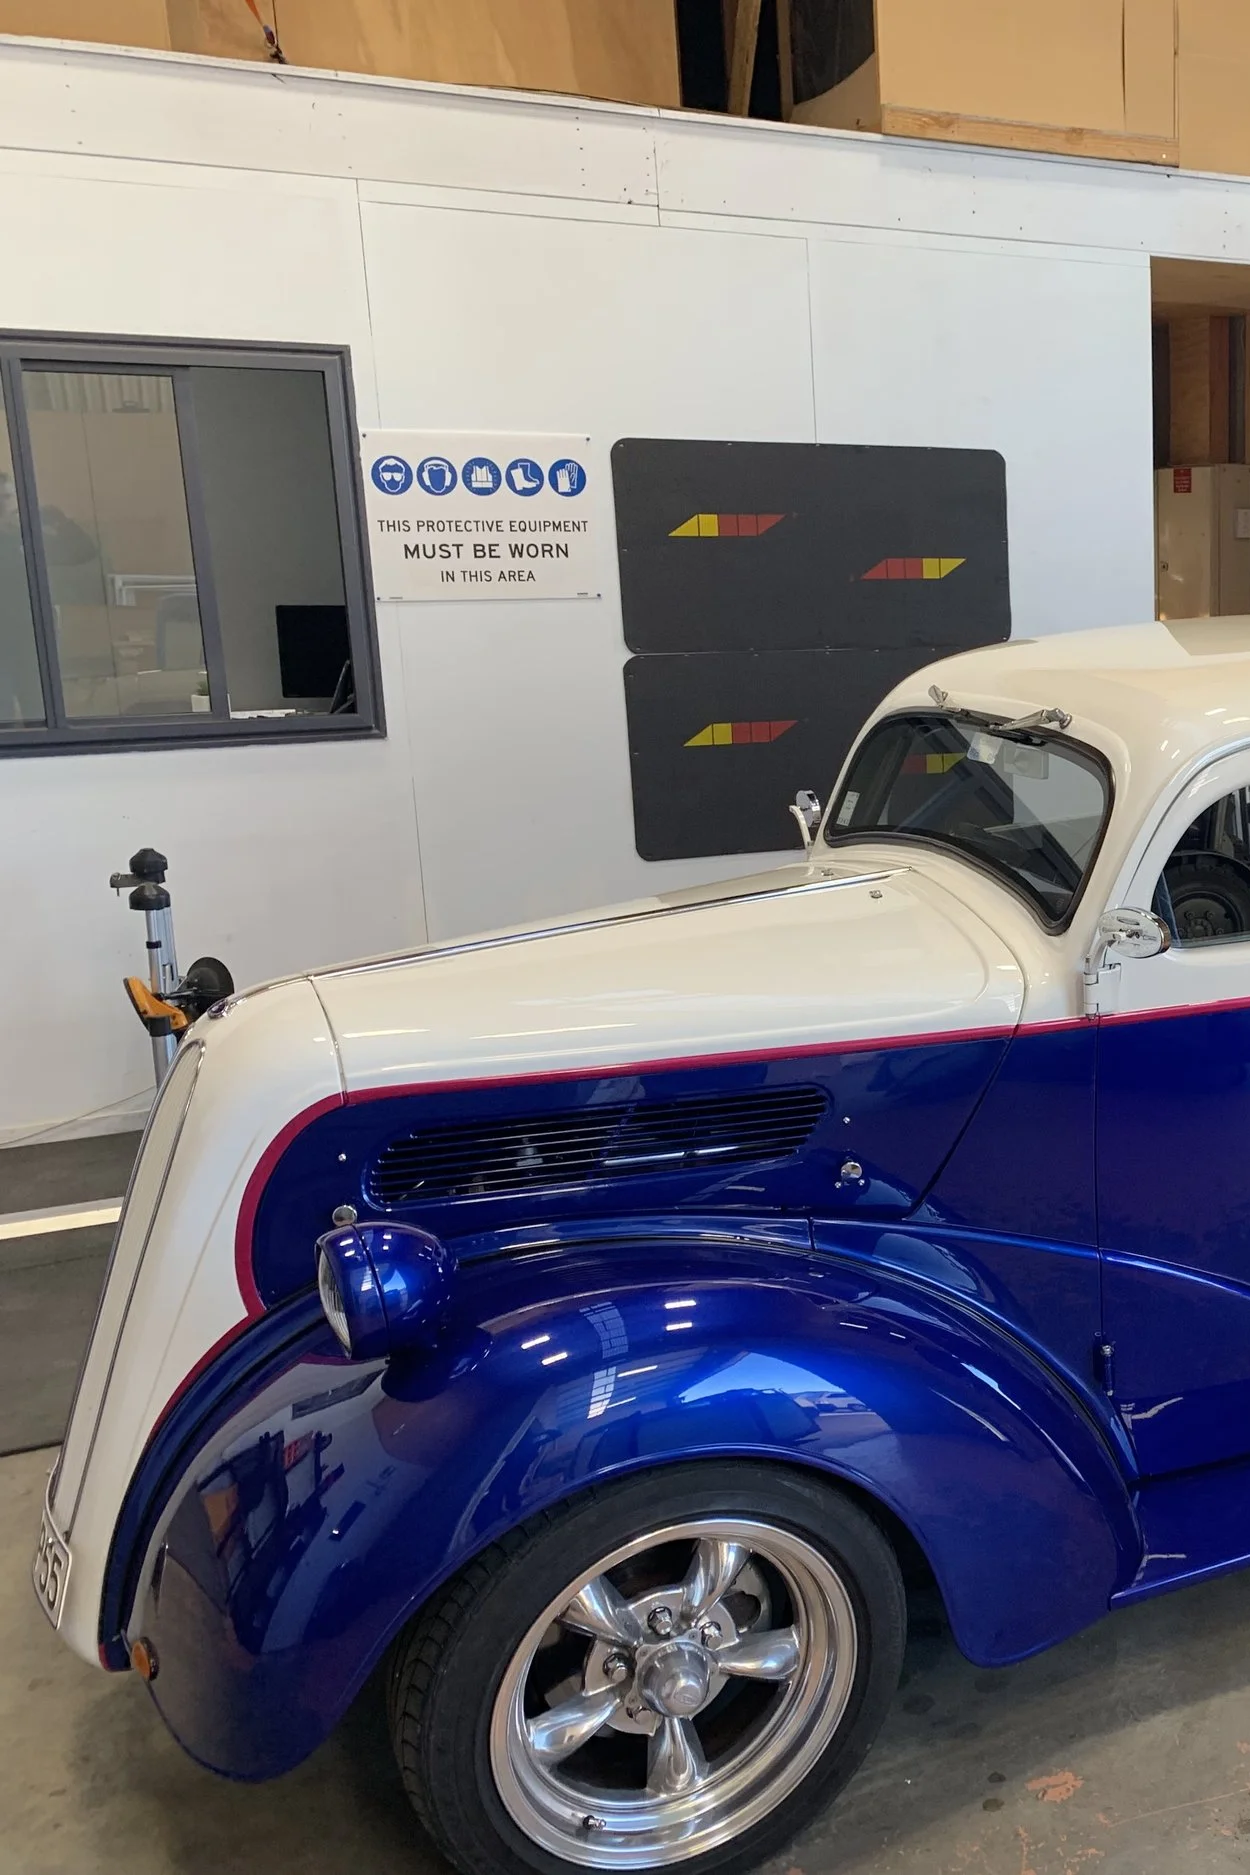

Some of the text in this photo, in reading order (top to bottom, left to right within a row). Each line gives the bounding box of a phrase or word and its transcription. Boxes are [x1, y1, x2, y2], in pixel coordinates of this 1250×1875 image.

[377, 519, 589, 533] THIS PROTECTIVE EQUIPMENT
[404, 543, 569, 559] MUST BE WORN
[440, 570, 536, 582] IN THIS AREA
